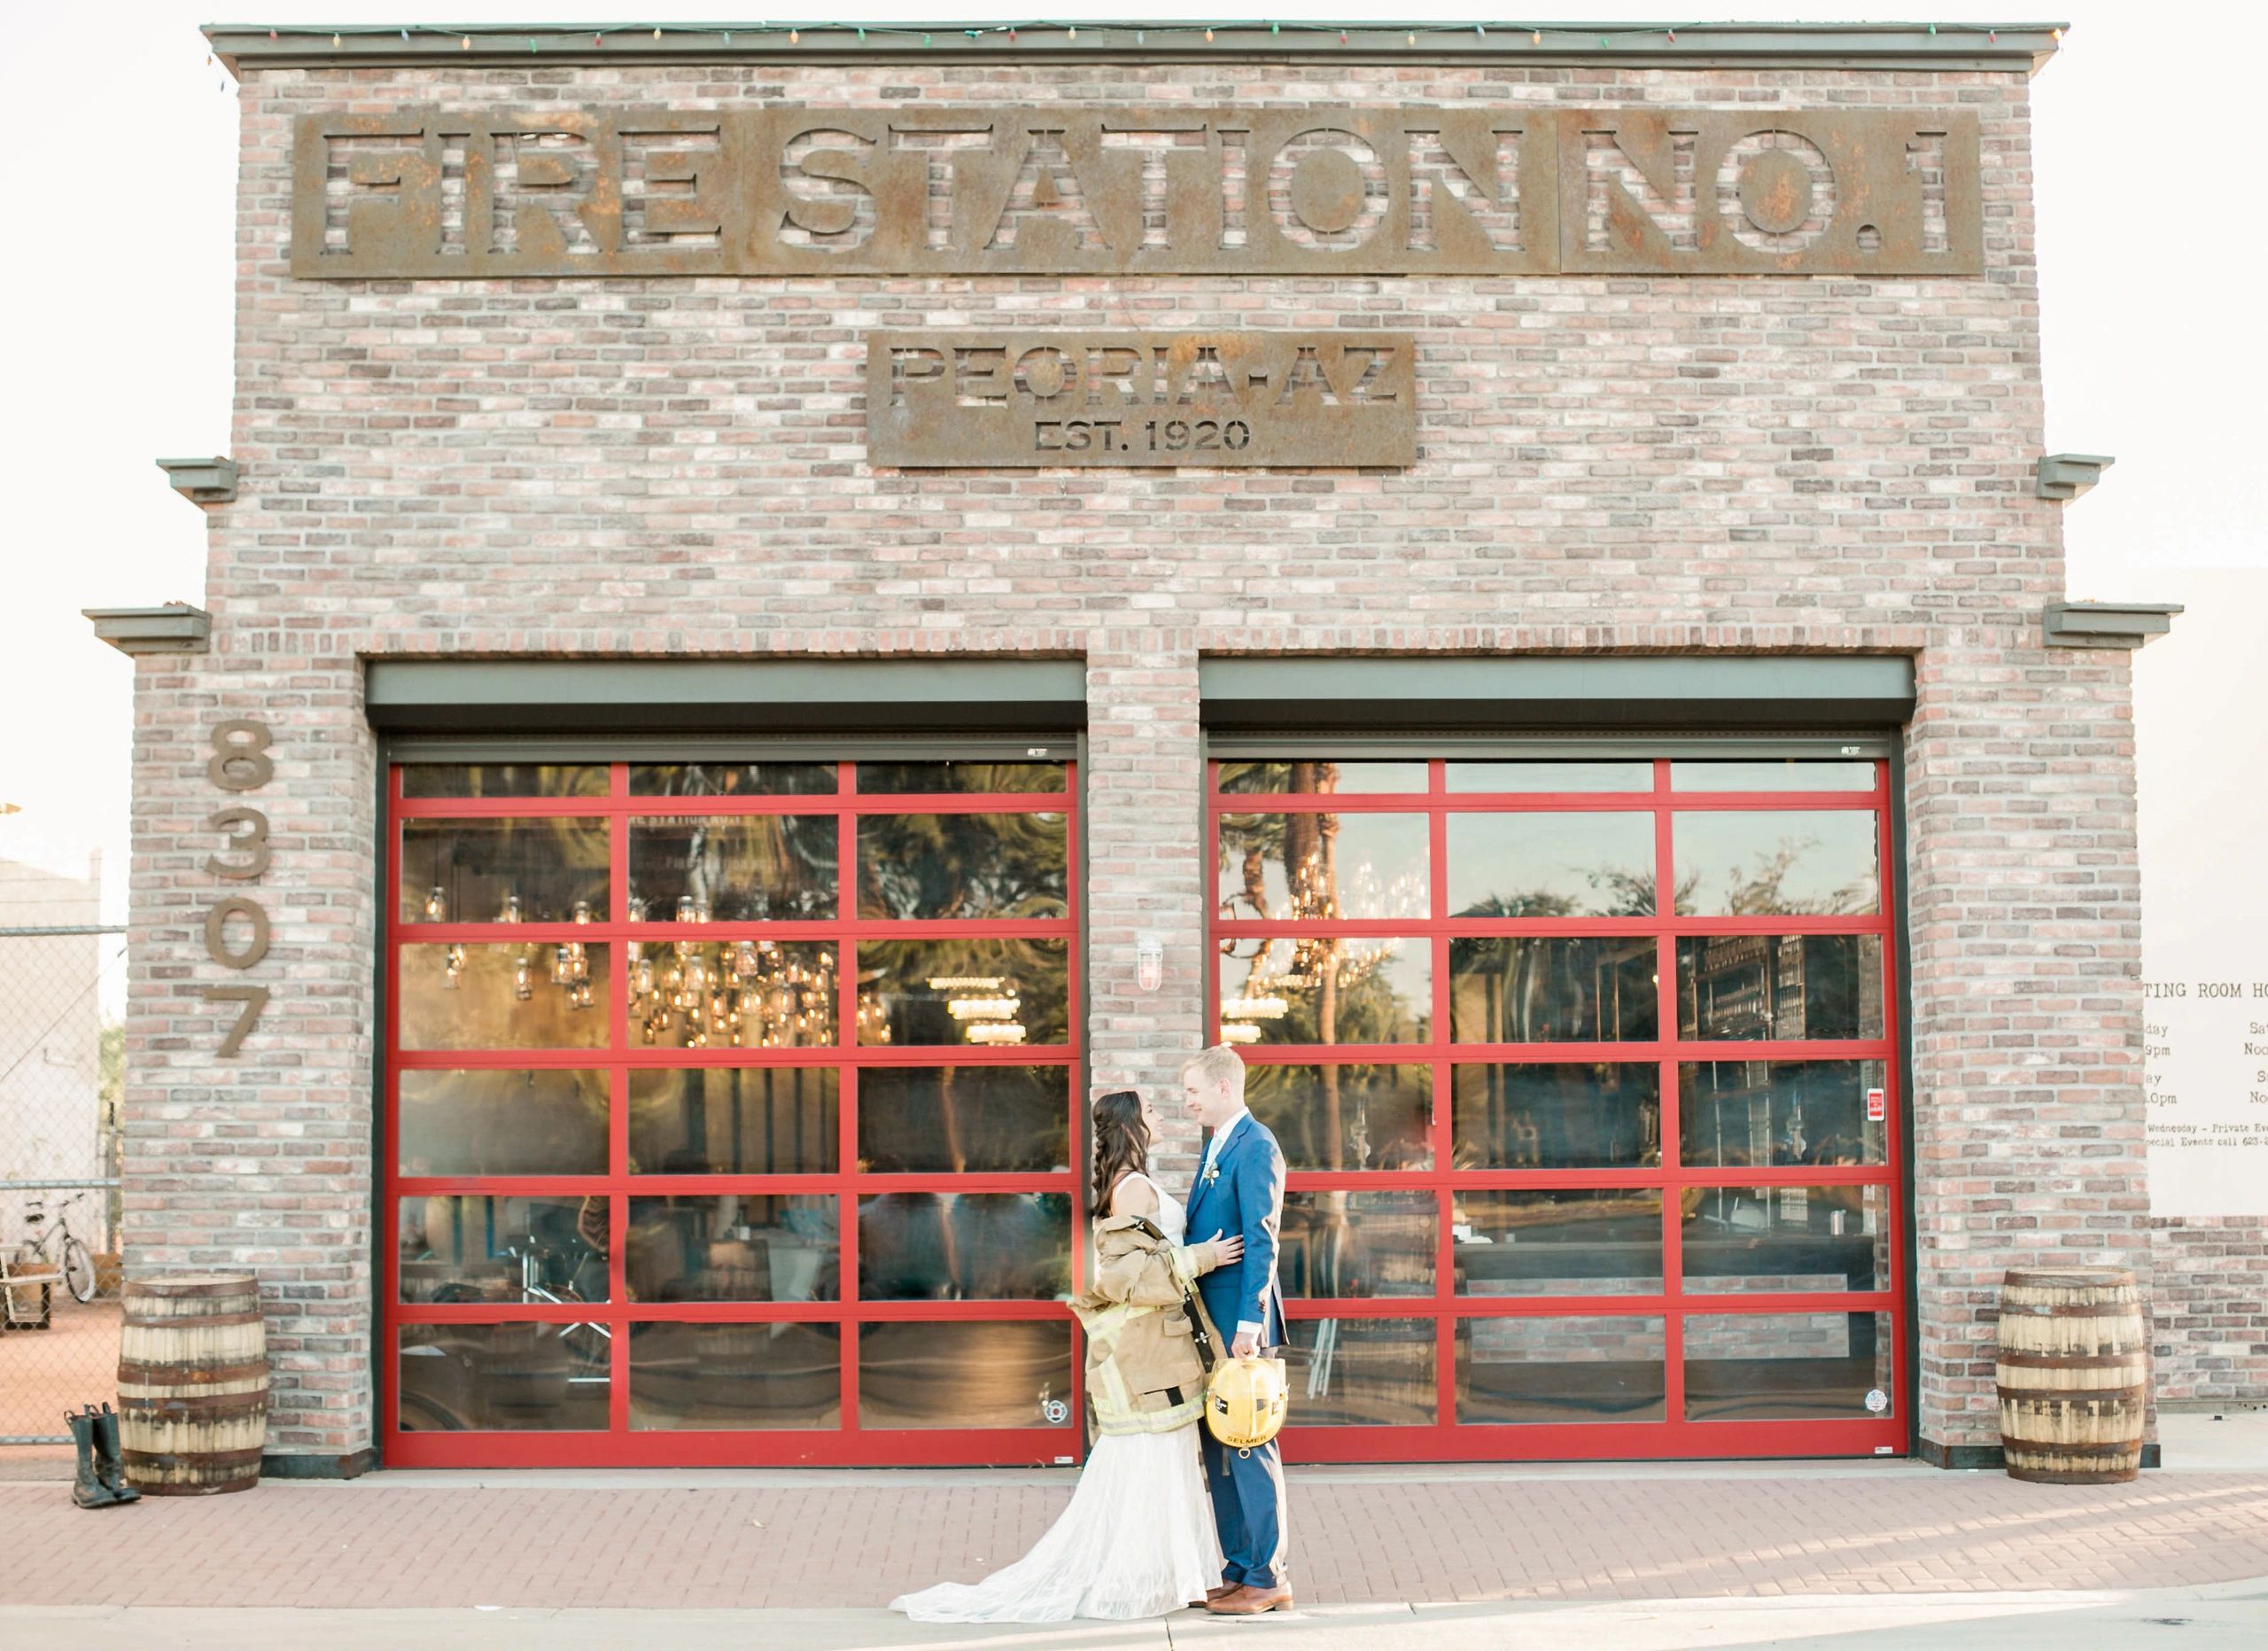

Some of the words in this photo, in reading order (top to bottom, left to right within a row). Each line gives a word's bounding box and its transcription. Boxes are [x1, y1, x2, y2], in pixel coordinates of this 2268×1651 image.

[320, 126, 722, 256] FIRE
[778, 124, 1526, 255] STATION
[1035, 420, 1130, 451] EST.
[1146, 420, 1250, 451] 1920
[204, 719, 274, 1058] 8307
[2143, 982, 2186, 998] TING
[2198, 983, 2241, 998] ROOM
[2250, 1022, 2268, 1034] Sa
[2148, 1124, 2197, 1134] Wednesday
[2212, 1124, 2249, 1133] Private
[2180, 1137, 2214, 1147] Events
[2218, 1137, 2237, 1146] call
[1227, 1435, 1267, 1445] SELMER
